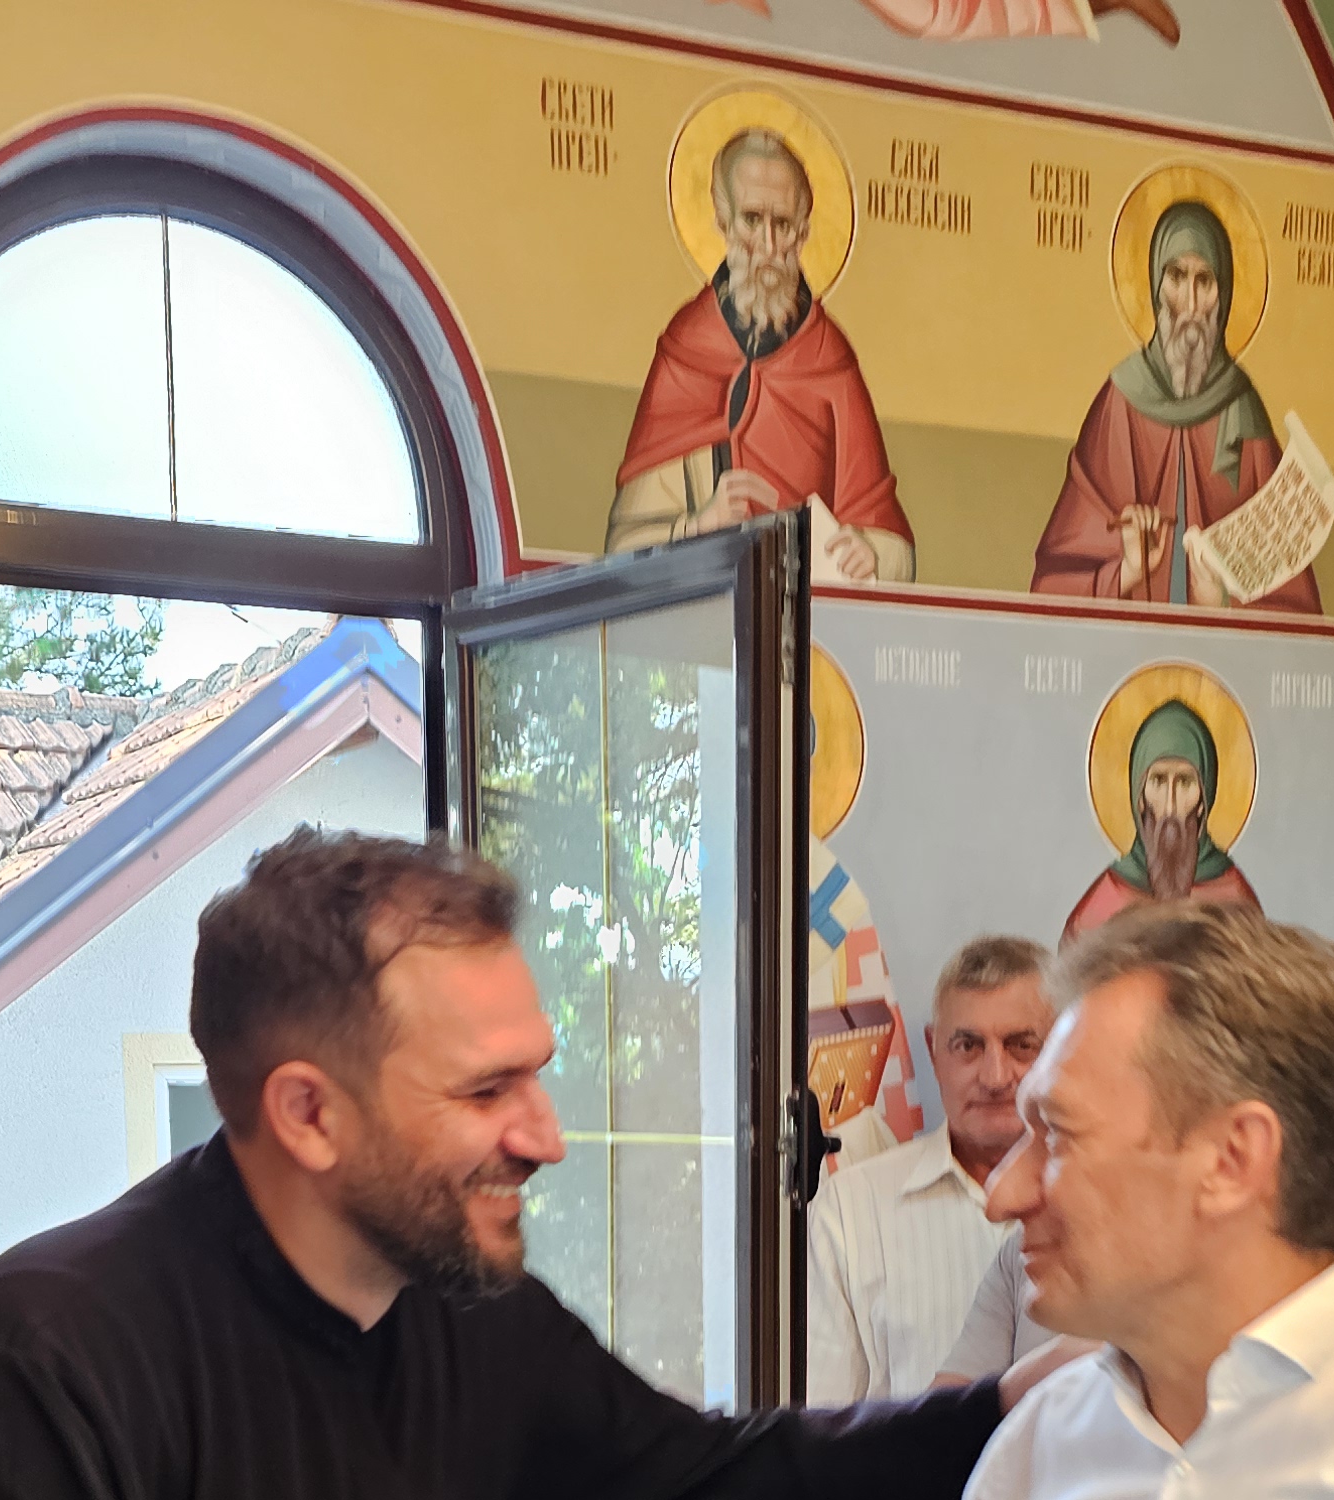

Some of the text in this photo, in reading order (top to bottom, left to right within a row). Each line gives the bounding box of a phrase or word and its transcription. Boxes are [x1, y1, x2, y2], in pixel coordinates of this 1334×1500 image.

[541, 76, 614, 132] СВЕТИ
[890, 138, 939, 185] САВА
[1030, 161, 1090, 209] СВЕТИ
[1024, 653, 1083, 696] СВЕТИ
